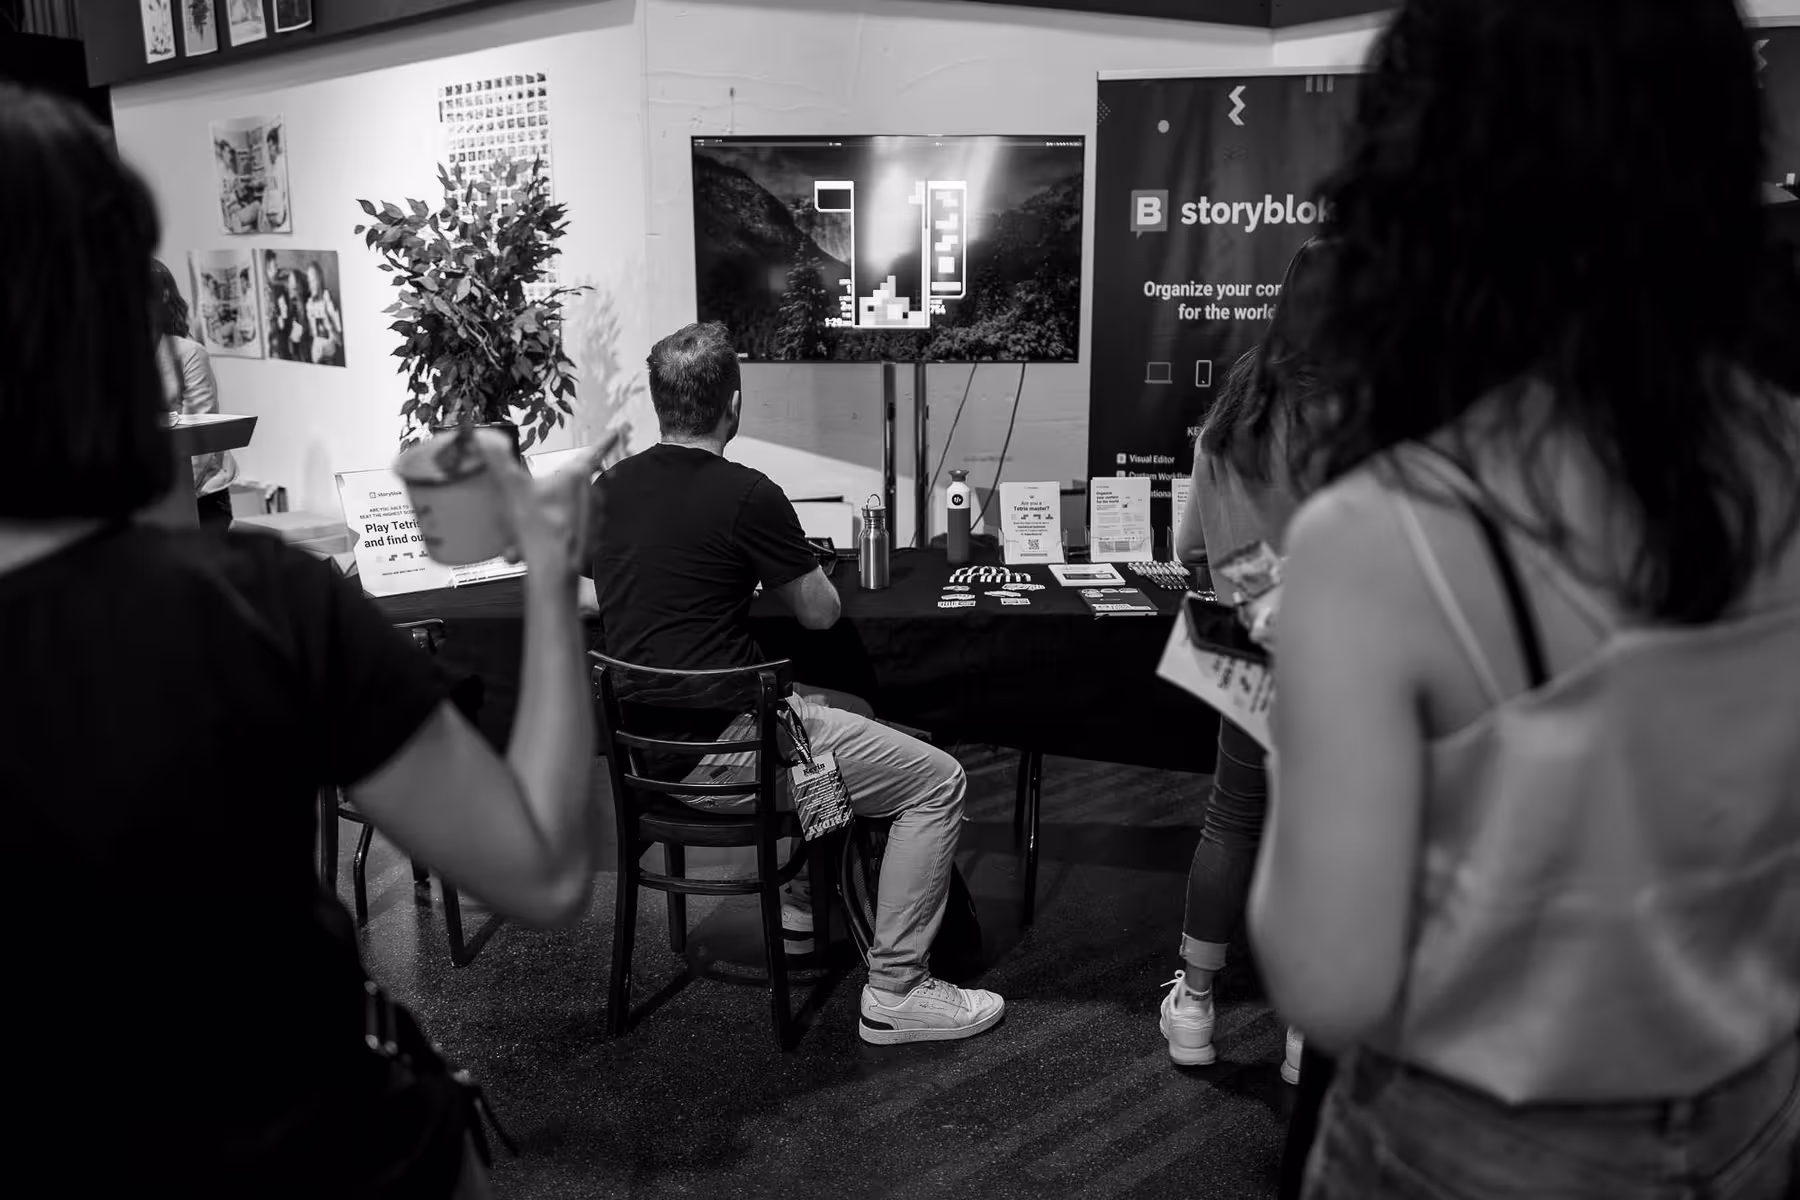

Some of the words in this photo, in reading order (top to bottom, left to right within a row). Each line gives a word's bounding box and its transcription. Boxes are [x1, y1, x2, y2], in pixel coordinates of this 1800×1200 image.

[1144, 281, 1213, 300] Organize
[1216, 284, 1252, 300] your
[1178, 304, 1201, 320] for
[1205, 304, 1230, 320] the
[1234, 303, 1277, 320] world
[1129, 454, 1152, 464] Visual
[1153, 455, 1175, 464] Editor
[365, 522, 389, 534] Play
[364, 536, 384, 548] and
[387, 534, 408, 546] find
[411, 534, 425, 544] ou
